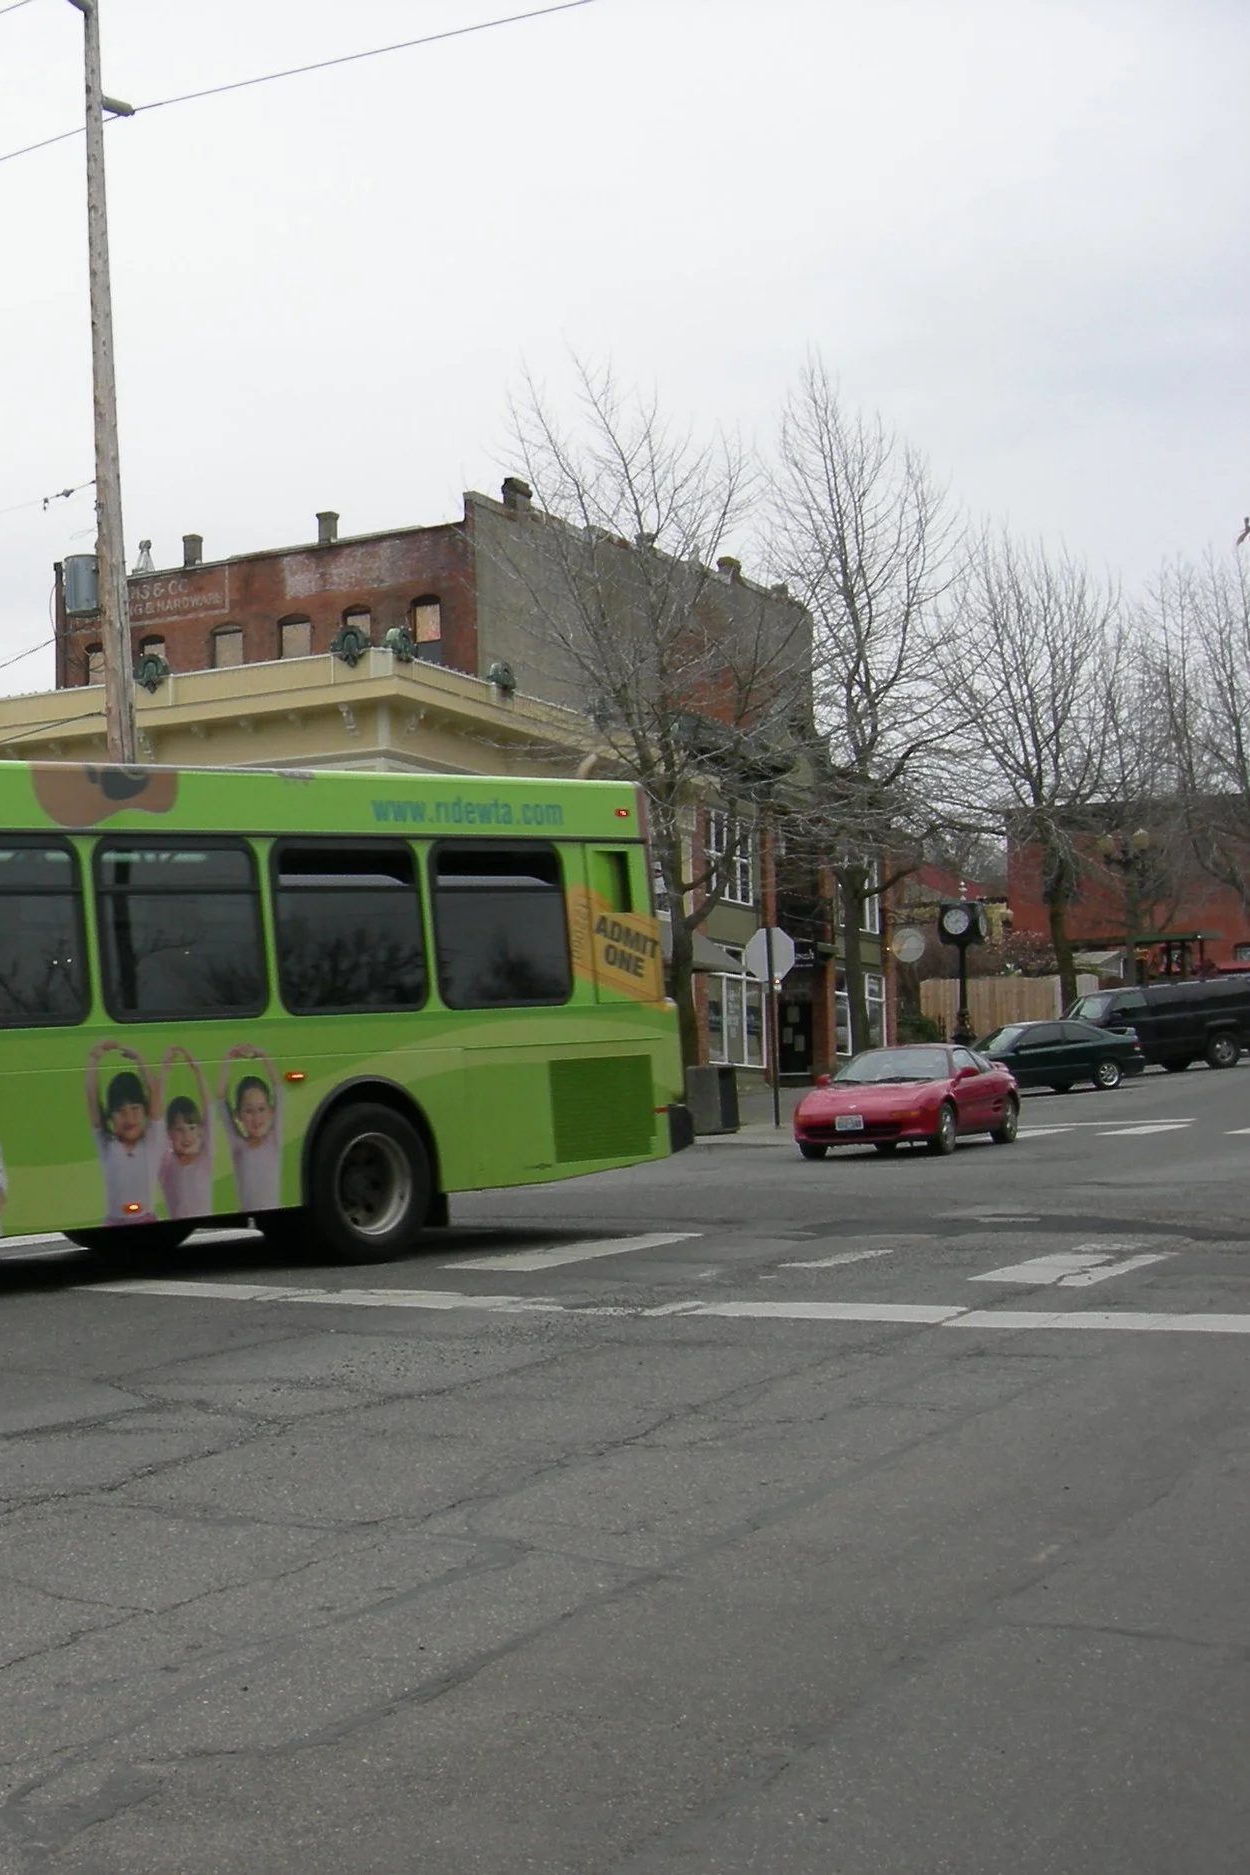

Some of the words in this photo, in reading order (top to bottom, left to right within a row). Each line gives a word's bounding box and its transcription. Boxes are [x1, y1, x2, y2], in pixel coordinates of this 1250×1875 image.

[153, 582, 165, 598] &
[370, 796, 564, 826] www.ridewta.com
[595, 914, 659, 960] ADMIT
[604, 944, 645, 979] ONE
